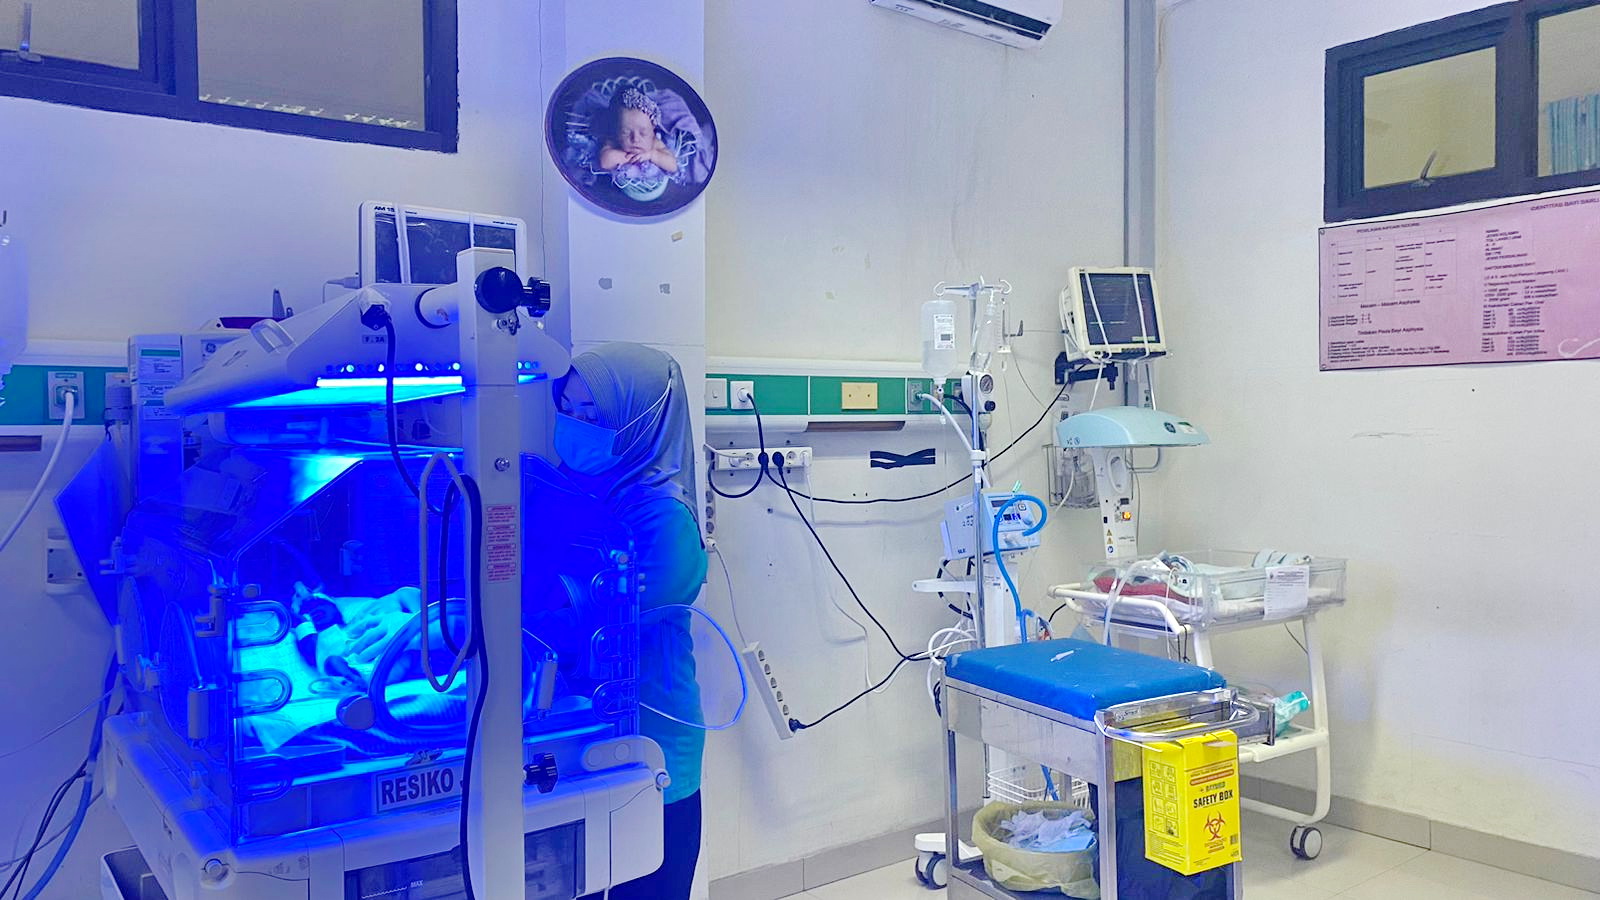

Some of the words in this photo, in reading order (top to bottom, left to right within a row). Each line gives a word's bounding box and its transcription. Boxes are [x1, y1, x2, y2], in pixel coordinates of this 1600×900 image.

[381, 768, 454, 805] RESIKO
[1194, 793, 1217, 808] SAFETY
[1219, 789, 1233, 801] BOX
